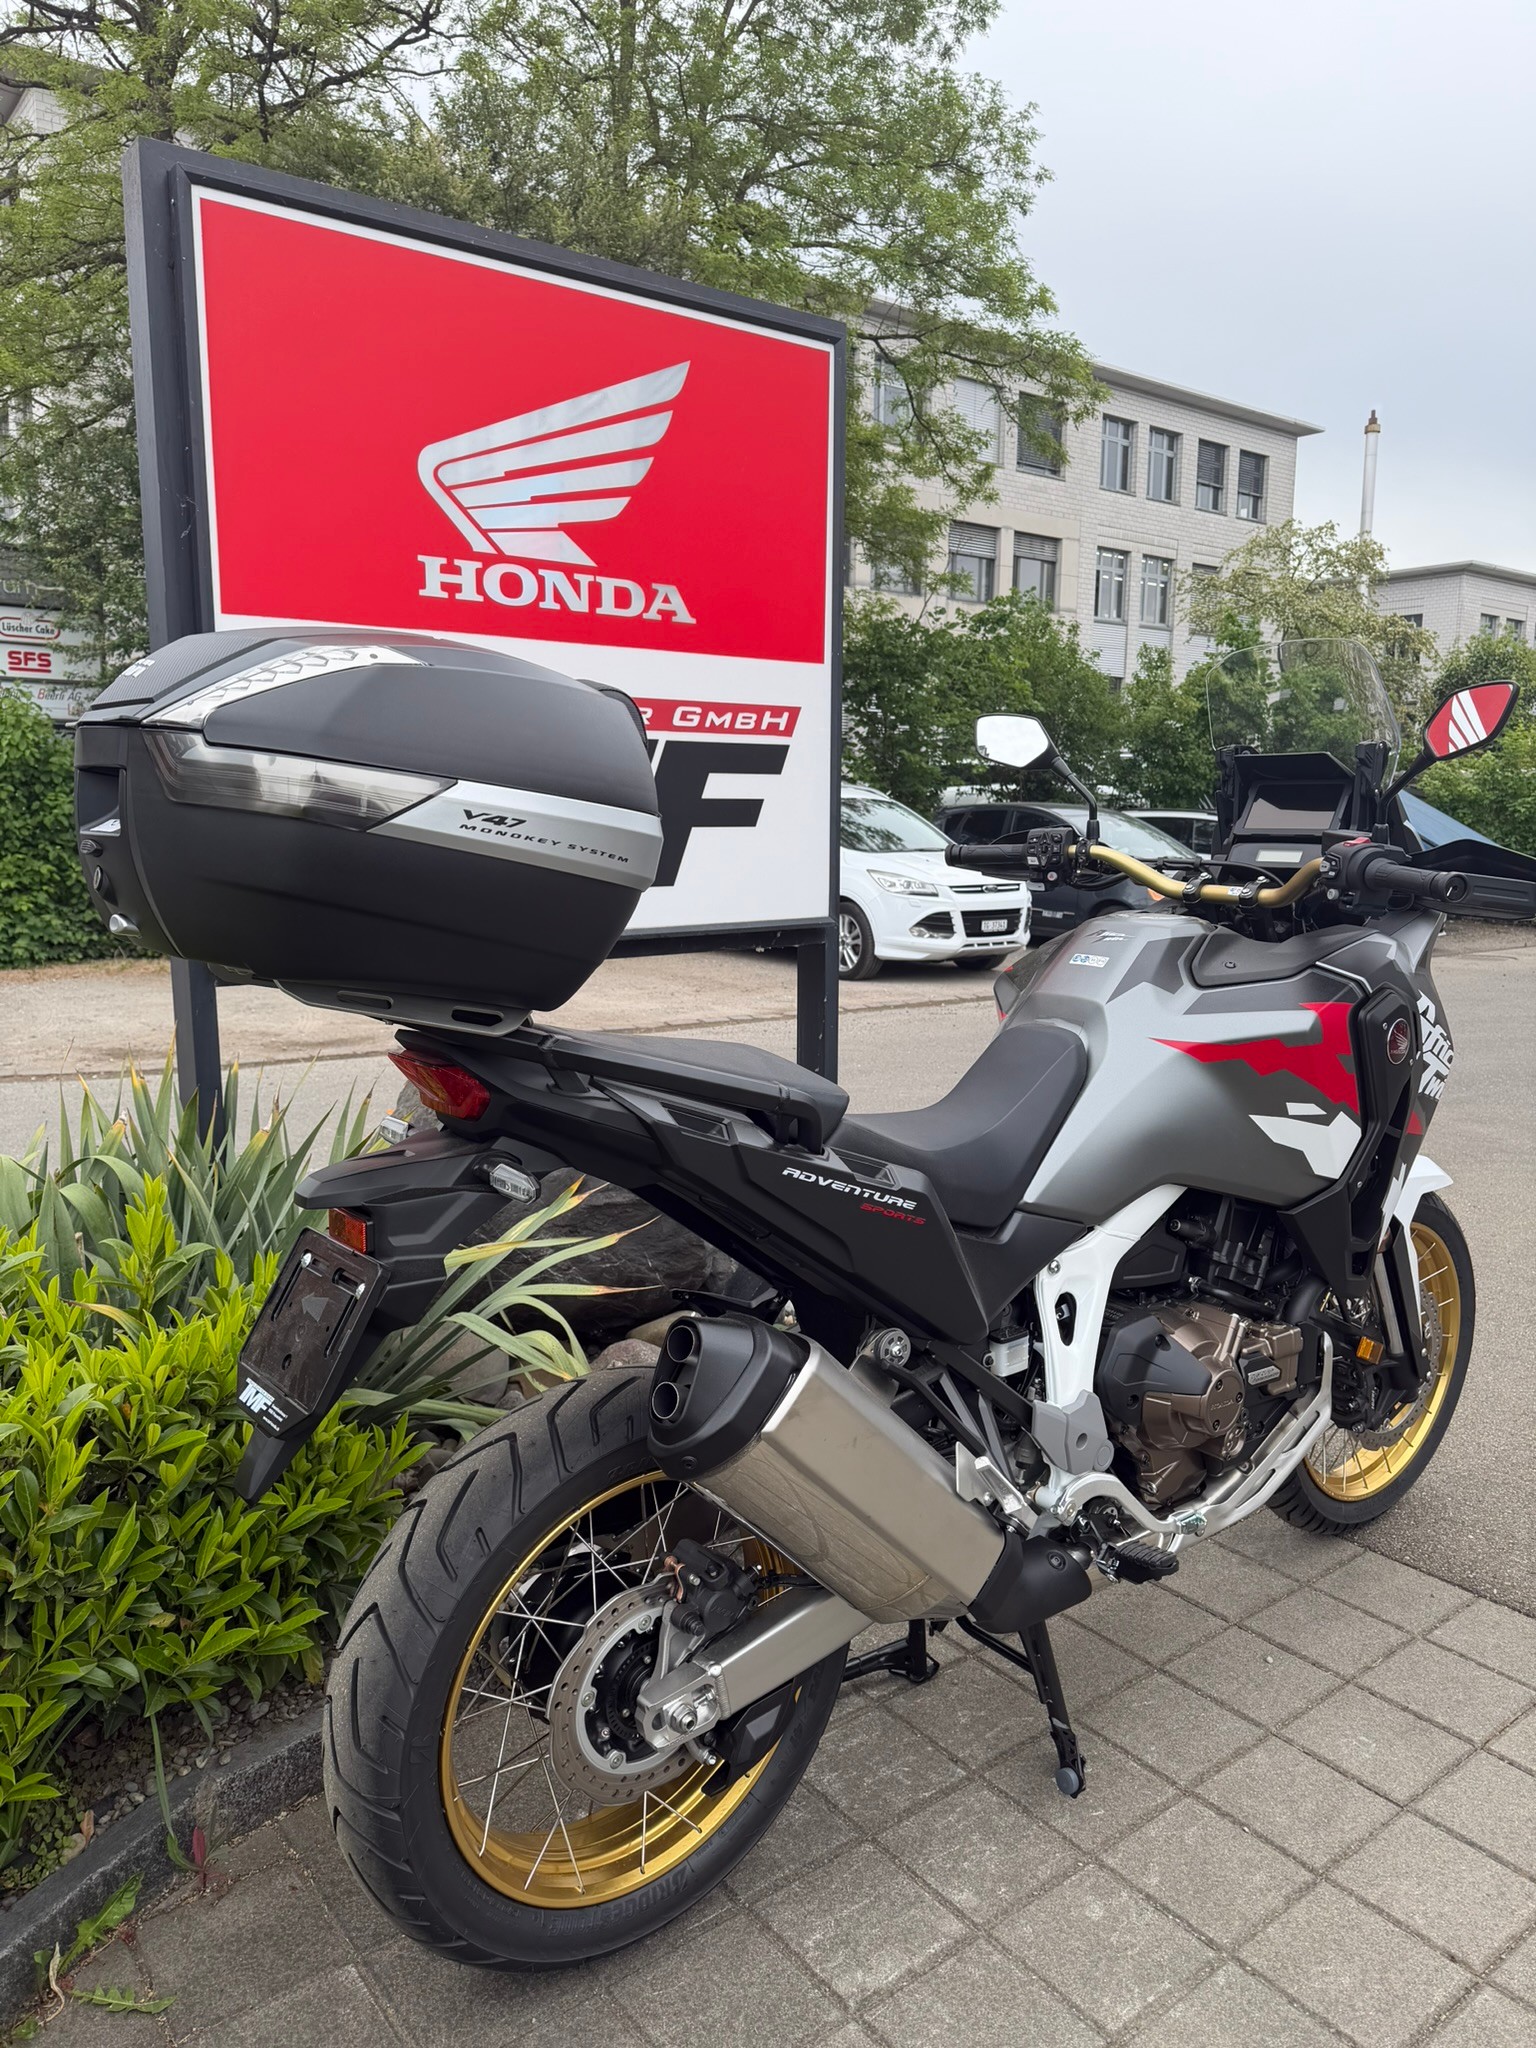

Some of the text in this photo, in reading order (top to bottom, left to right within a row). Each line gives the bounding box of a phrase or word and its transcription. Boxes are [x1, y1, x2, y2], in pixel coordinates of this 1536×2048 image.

[417, 554, 697, 625] HONDA
[2, 622, 32, 633] Lüscher
[8, 650, 52, 668] SFS
[463, 809, 527, 828] V47
[459, 823, 629, 863] MONOKEY SYSTEM
[781, 1166, 917, 1210] ADVENTURE
[860, 1202, 926, 1226] SPORTS
